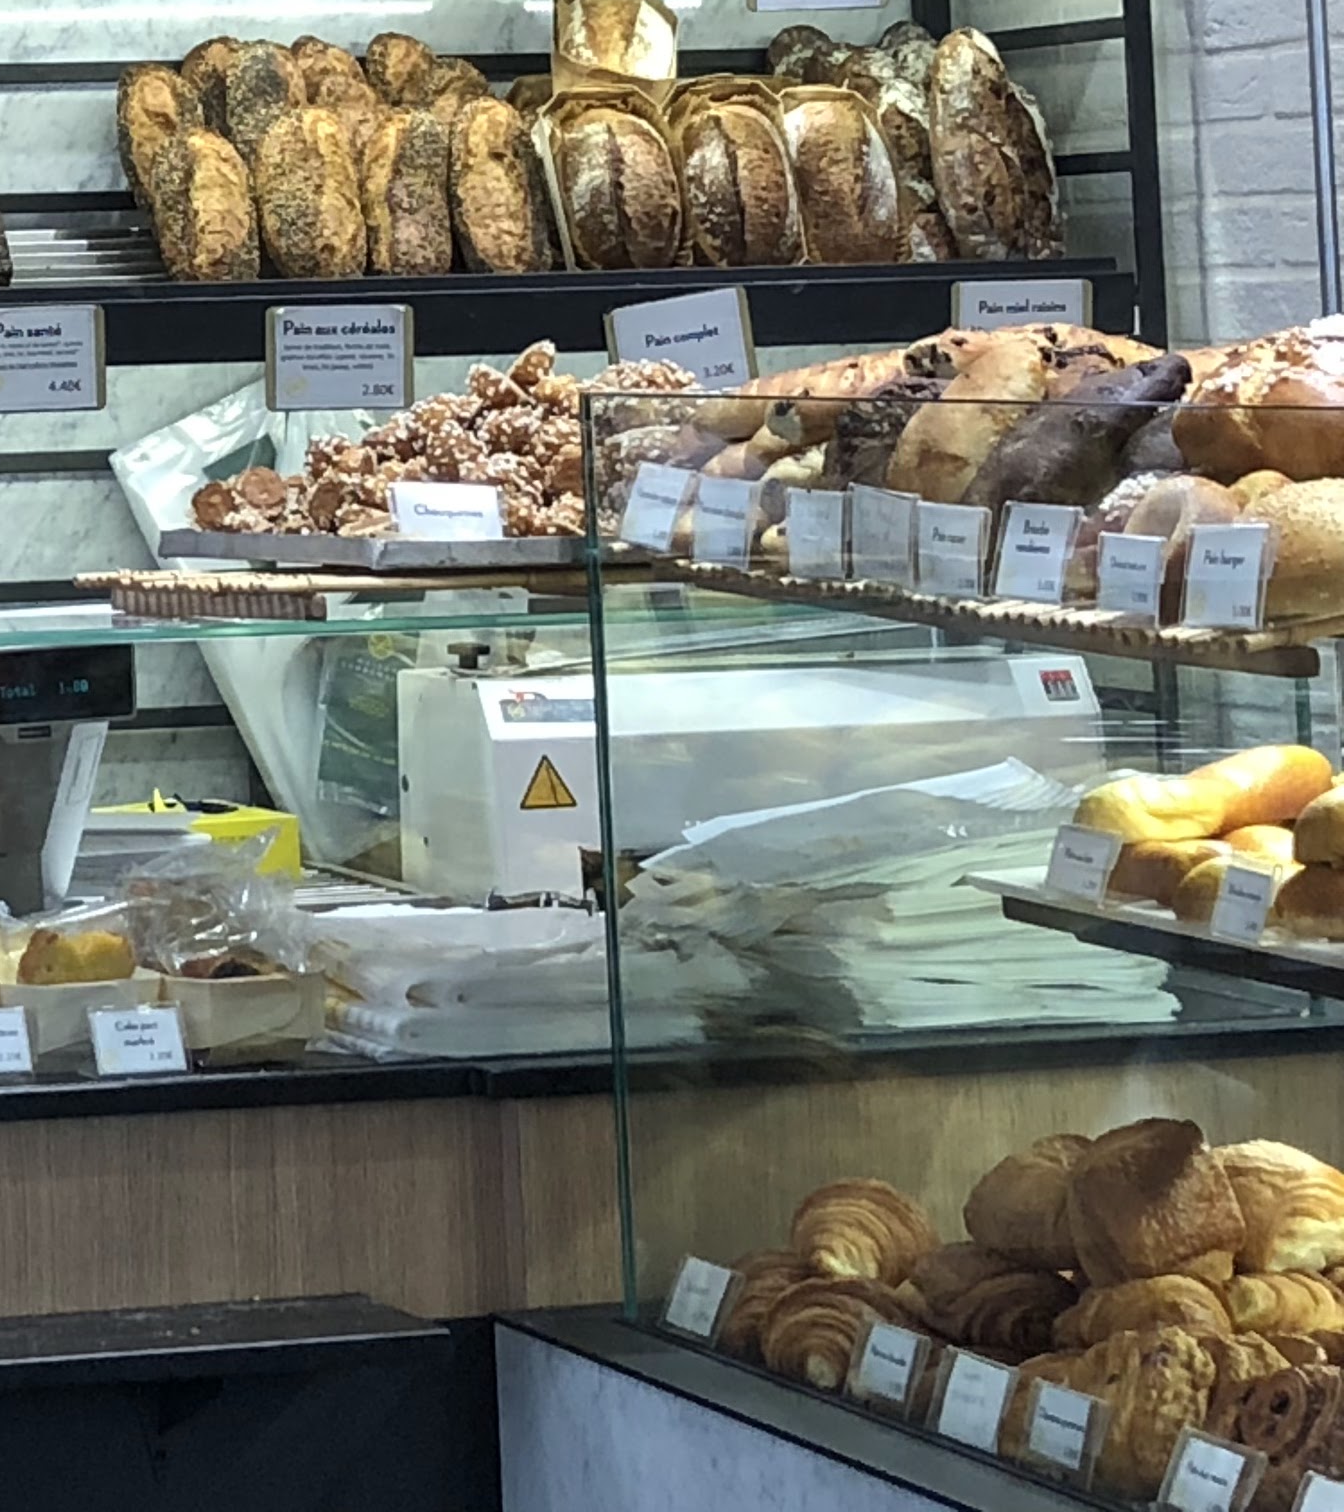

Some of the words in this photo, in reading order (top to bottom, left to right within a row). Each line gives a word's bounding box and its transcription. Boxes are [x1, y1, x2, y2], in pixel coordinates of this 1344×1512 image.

[978, 300, 1004, 314] Pain
[26, 322, 63, 338] santé
[282, 320, 313, 336] Pain
[340, 318, 396, 336] céréales
[644, 334, 672, 348] Pain
[672, 323, 720, 343] complet
